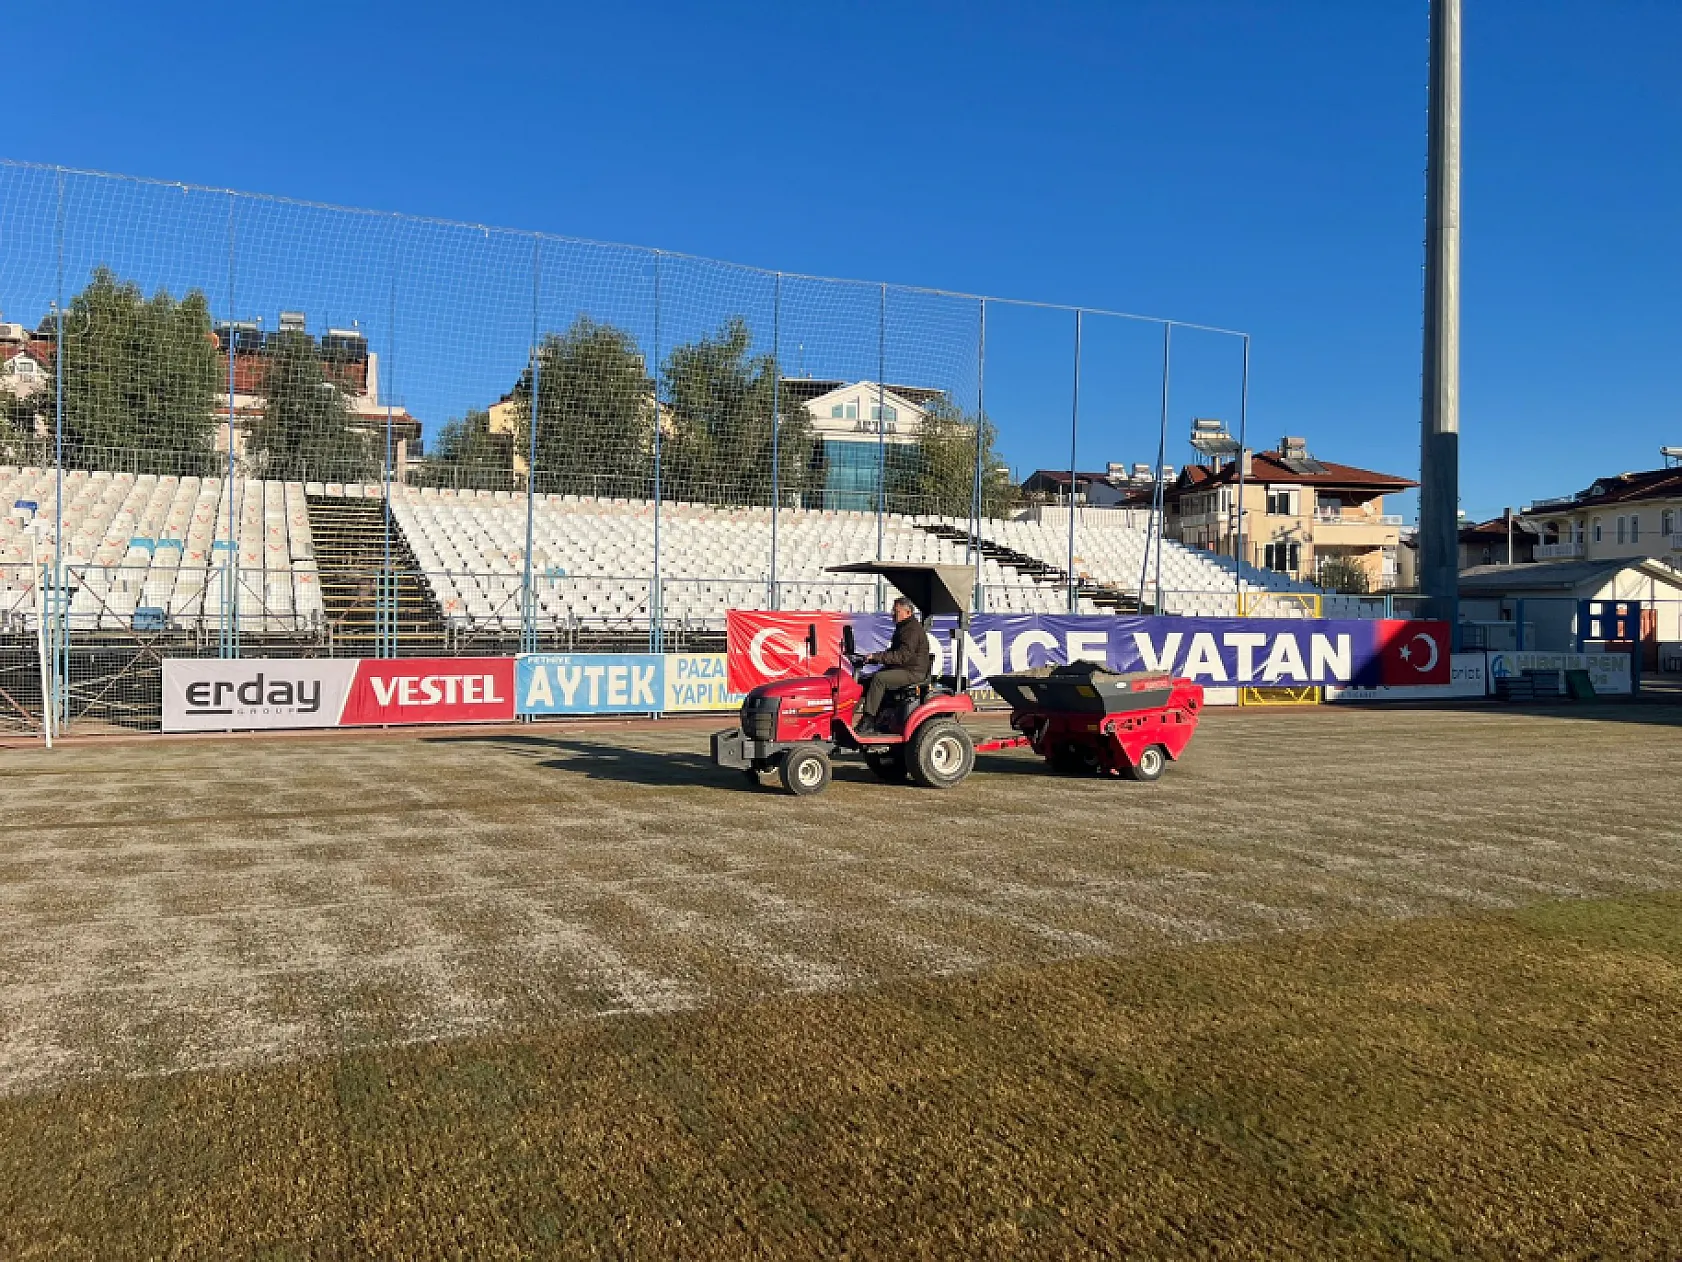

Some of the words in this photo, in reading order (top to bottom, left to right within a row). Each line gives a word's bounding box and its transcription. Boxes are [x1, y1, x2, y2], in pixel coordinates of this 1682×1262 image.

[676, 658, 727, 679] PAZA
[1133, 631, 1352, 682] VATAN
[185, 673, 321, 713] erday
[370, 675, 505, 707] VESTEL
[525, 665, 656, 707] AYTEK
[671, 683, 713, 705] YAPI
